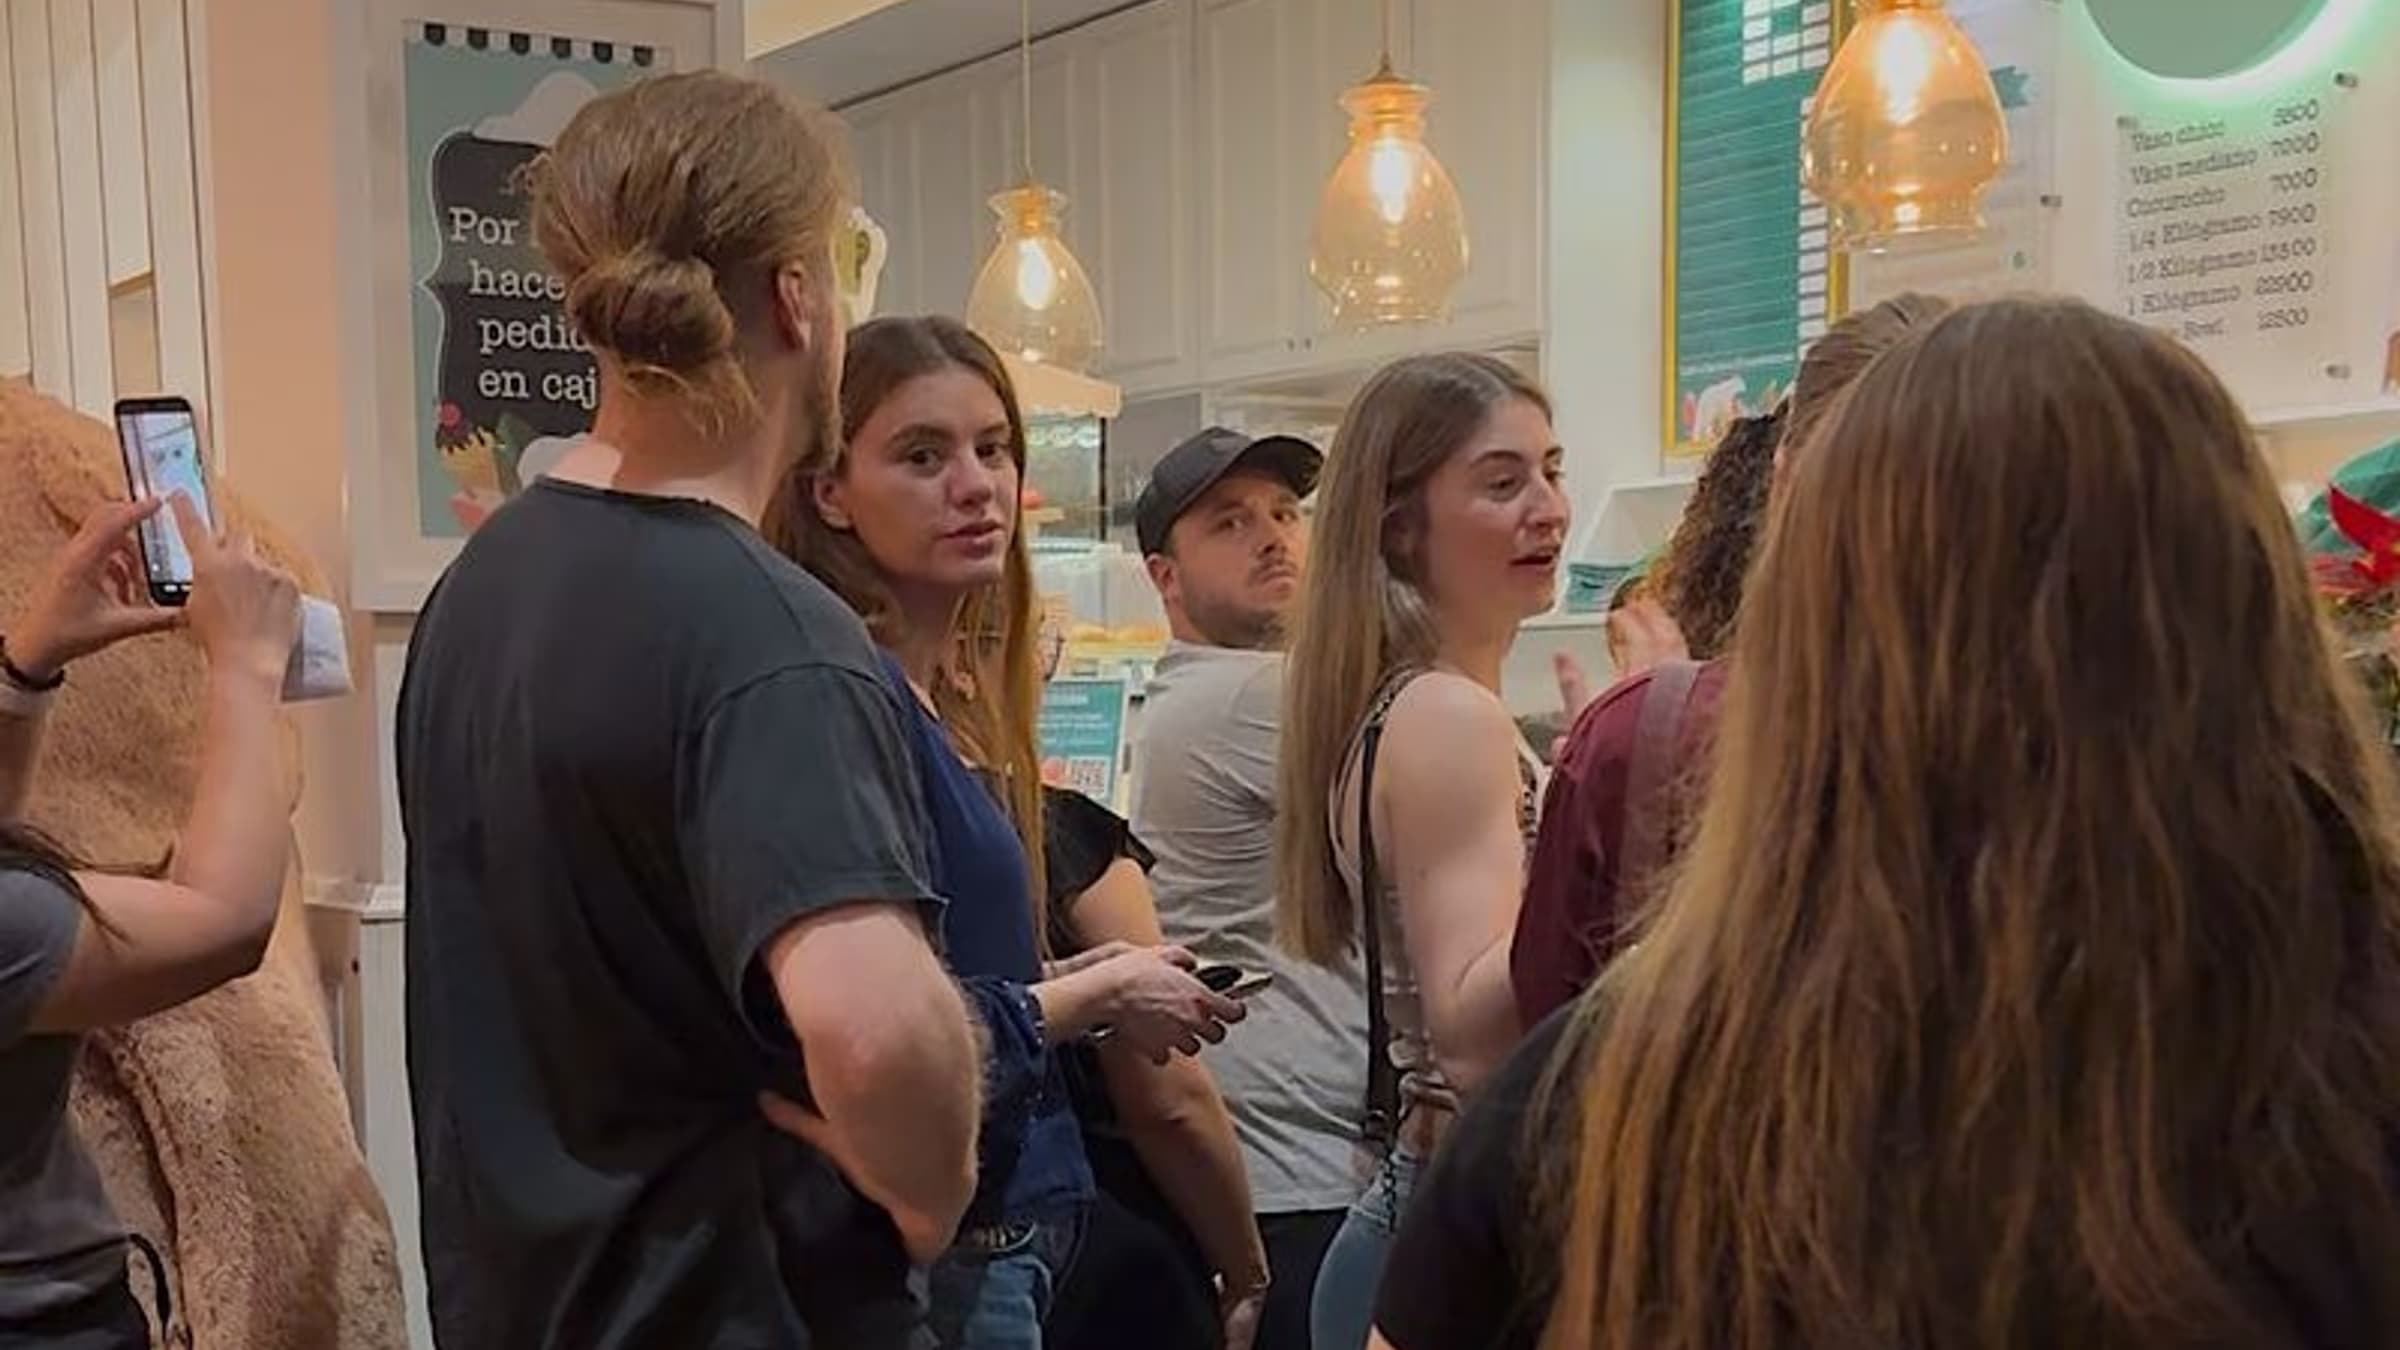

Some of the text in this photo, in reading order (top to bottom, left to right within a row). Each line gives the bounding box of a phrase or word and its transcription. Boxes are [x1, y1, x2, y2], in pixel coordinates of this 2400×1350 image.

[2131, 131, 2173, 152] Vaso
[2131, 164, 2173, 185] Vaso
[2176, 149, 2258, 178] mediano
[449, 206, 520, 245] Por
[2163, 214, 2262, 244] Kilogramo
[469, 259, 567, 299] hace
[2158, 249, 2257, 278] Kilogramo
[2142, 285, 2241, 313] Kilogramo
[478, 314, 594, 353] pedi
[479, 366, 598, 410] en caj
